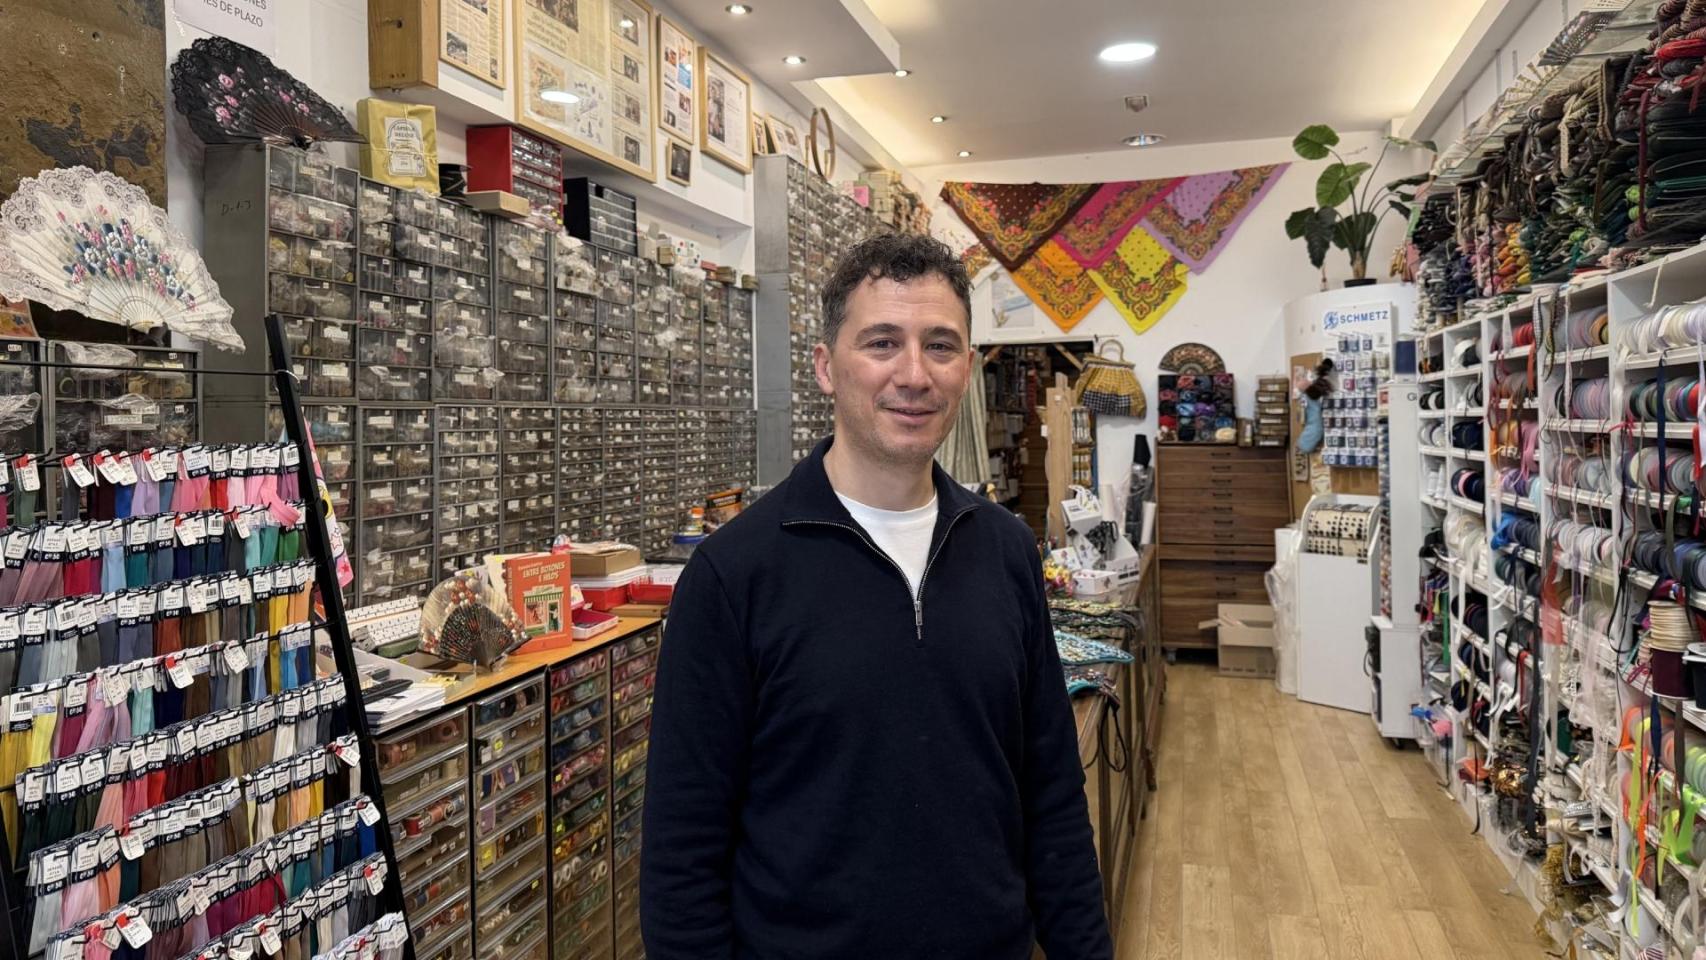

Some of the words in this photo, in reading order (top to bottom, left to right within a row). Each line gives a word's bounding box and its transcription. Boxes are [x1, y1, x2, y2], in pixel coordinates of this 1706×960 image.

[220, 1, 233, 14] DE
[234, 7, 263, 27] PLAZO
[1340, 310, 1388, 324] SCHMETZ
